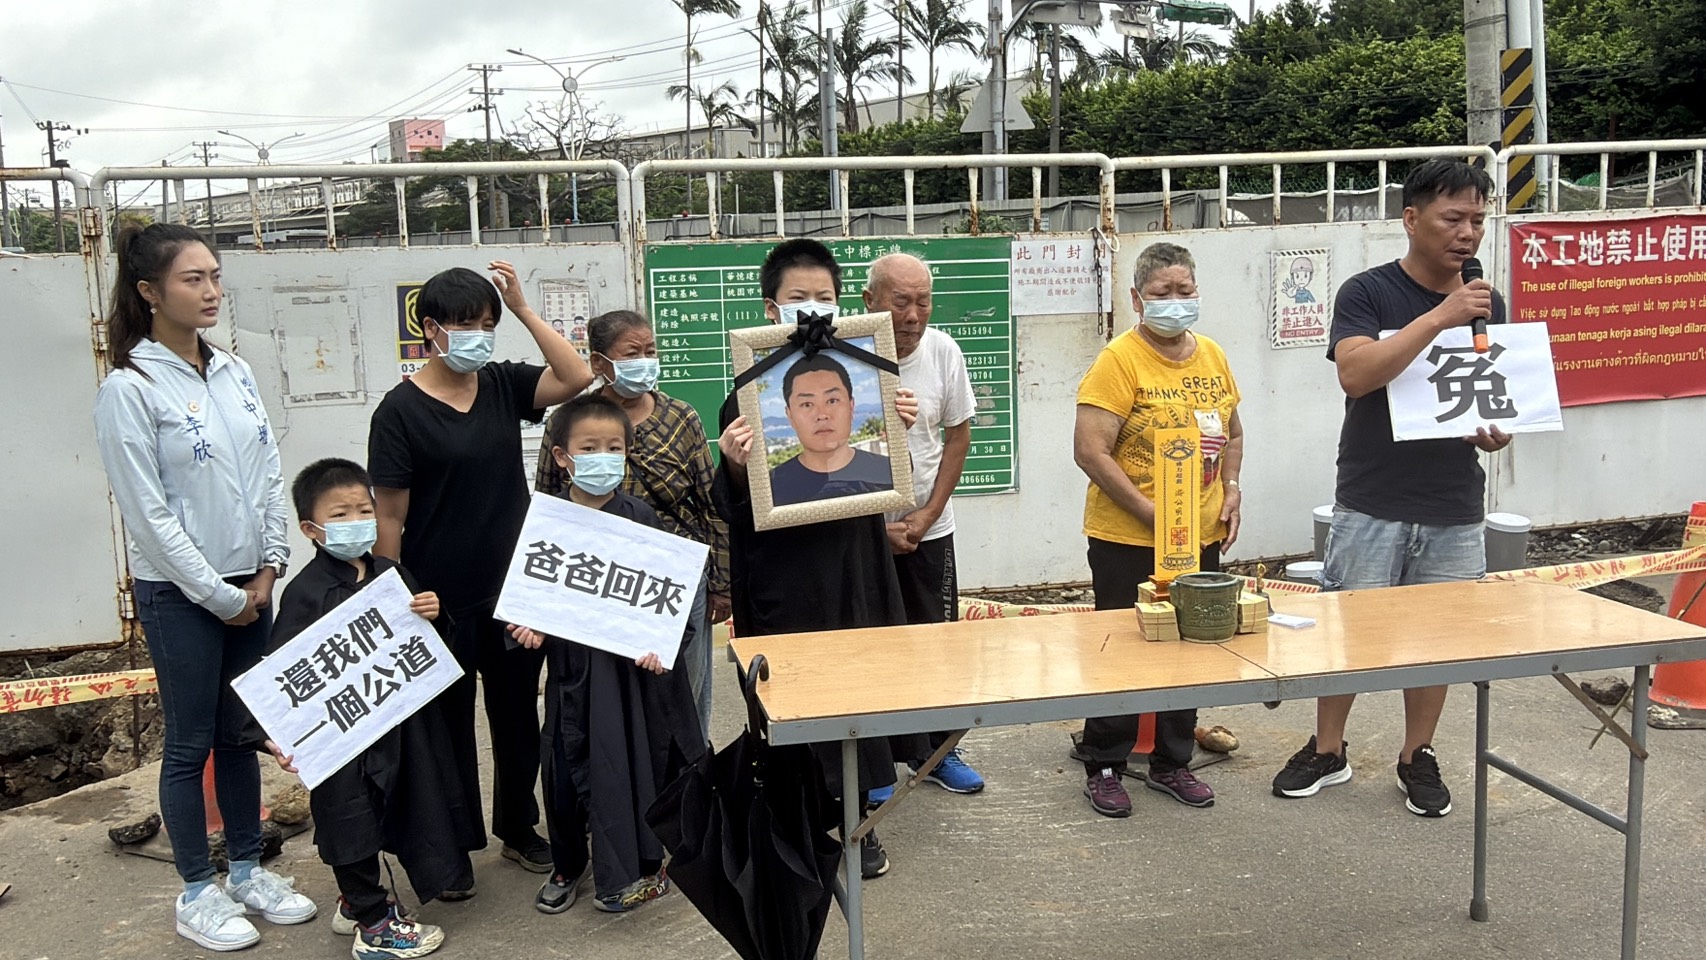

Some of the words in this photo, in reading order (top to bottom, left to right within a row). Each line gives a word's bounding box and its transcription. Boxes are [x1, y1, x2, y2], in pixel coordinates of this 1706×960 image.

[1522, 224, 1706, 270] 本工地禁止使用
[658, 273, 698, 283] 工程名稱
[1521, 280, 1538, 292] The
[1540, 282, 1556, 291] use
[1558, 279, 1568, 290] of
[1569, 278, 1595, 291] illegal
[1597, 276, 1627, 289] foreign
[1629, 274, 1663, 286] workers
[1664, 273, 1672, 284] is
[659, 289, 698, 299] 建築基地
[680, 312, 719, 322] 執照字號
[1282, 303, 1324, 316] 非工作人員
[1520, 307, 1536, 321] Việc
[1551, 307, 1567, 320] dụng
[1570, 305, 1581, 316] lao
[1584, 303, 1600, 318] động
[1672, 297, 1687, 312] pháp
[1690, 297, 1696, 310] bị
[1282, 316, 1323, 329] 禁止進入
[1550, 333, 1576, 343] unaan
[1577, 330, 1608, 342] tenaga
[1610, 328, 1631, 341] kerja
[1633, 325, 1657, 339] asing
[1659, 323, 1683, 336] ilegal
[661, 338, 690, 347] 起造人
[662, 353, 691, 363] 設計人
[963, 356, 997, 365] 823131
[662, 369, 691, 378] 監造人
[1426, 342, 1518, 423] 冤
[1182, 376, 1224, 390] GREAT
[1136, 386, 1188, 402] THANKS
[1190, 390, 1207, 404] TO
[184, 414, 215, 461] 李欣
[523, 540, 687, 617] 爸爸回來
[274, 607, 394, 708] 還我們
[292, 634, 438, 748] 一個公道
